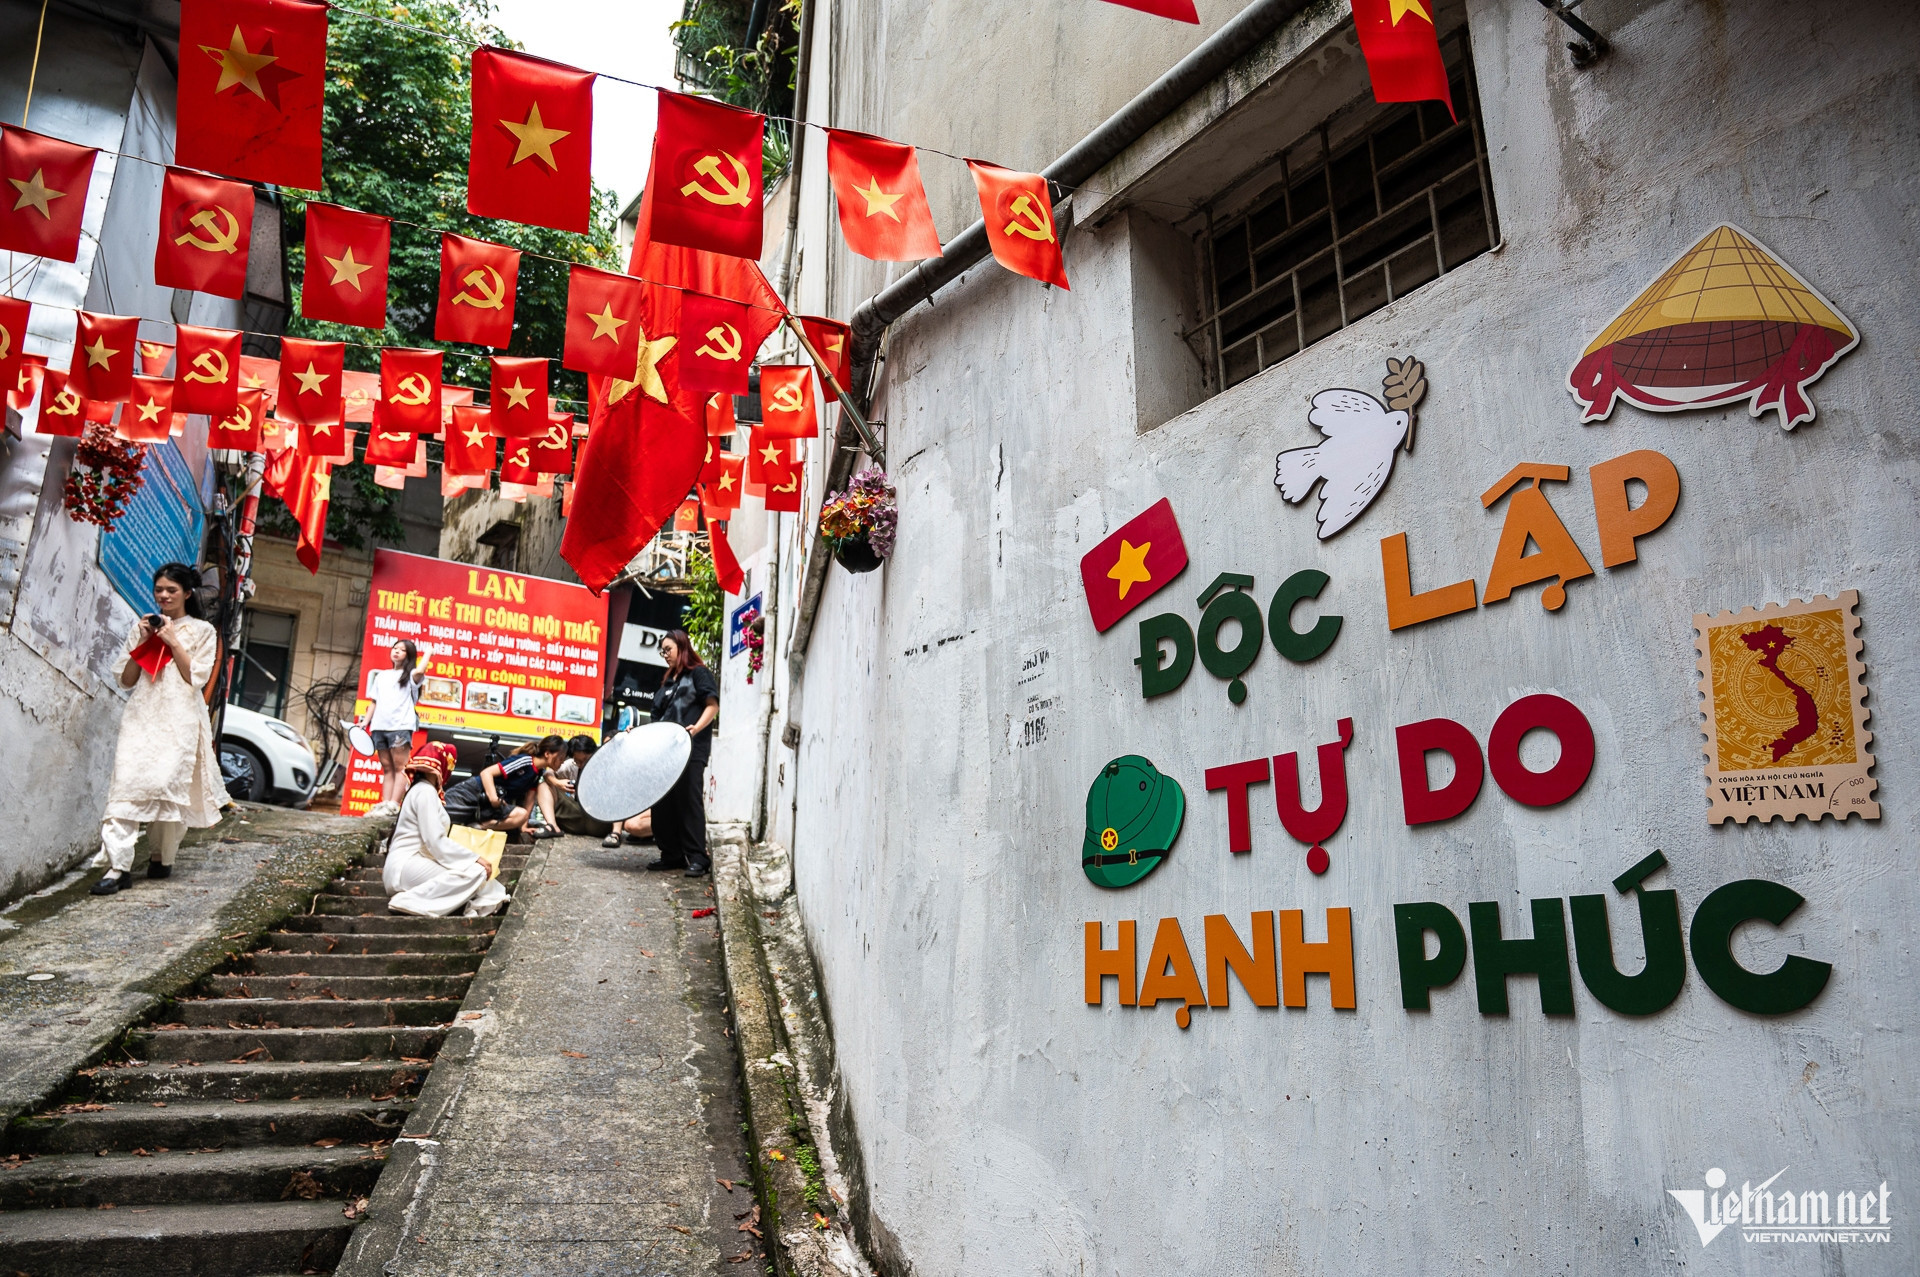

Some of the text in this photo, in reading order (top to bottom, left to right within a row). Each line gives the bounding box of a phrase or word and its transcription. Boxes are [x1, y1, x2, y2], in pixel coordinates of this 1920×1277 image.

[468, 570, 526, 604] LAN
[1133, 449, 1682, 704] ĐỘC LẬP
[377, 589, 601, 645] THIẾT KẾ THI CÔNG NỘI THẤT
[429, 624, 455, 640] THẠCH
[456, 630, 473, 642] CAO
[478, 631, 497, 646] GIẤY
[546, 641, 565, 657] GIẤY
[436, 662, 463, 678] ĐẶT
[466, 666, 488, 681] TẠI
[489, 669, 526, 686] CÔNG
[529, 675, 567, 691] TRÌNH
[459, 646, 470, 659] TA
[470, 648, 481, 660] PI
[486, 648, 504, 663] XỐP
[504, 652, 528, 668] THẢM
[529, 656, 546, 670] CÁC
[546, 659, 564, 674] LOẠI
[569, 662, 586, 676] SÀN
[1204, 693, 1595, 876] TỰ DO
[1718, 776, 1738, 784] CỘNG
[1756, 773, 1766, 781] XÃ
[1767, 773, 1781, 782] HỘI
[1782, 771, 1798, 780] CHỦ
[1799, 771, 1824, 779] NGHĨA
[1719, 782, 1826, 806] VIỆT NAM
[1851, 797, 1866, 805] 886
[1084, 849, 1833, 1029] HẠNH PHÚC
